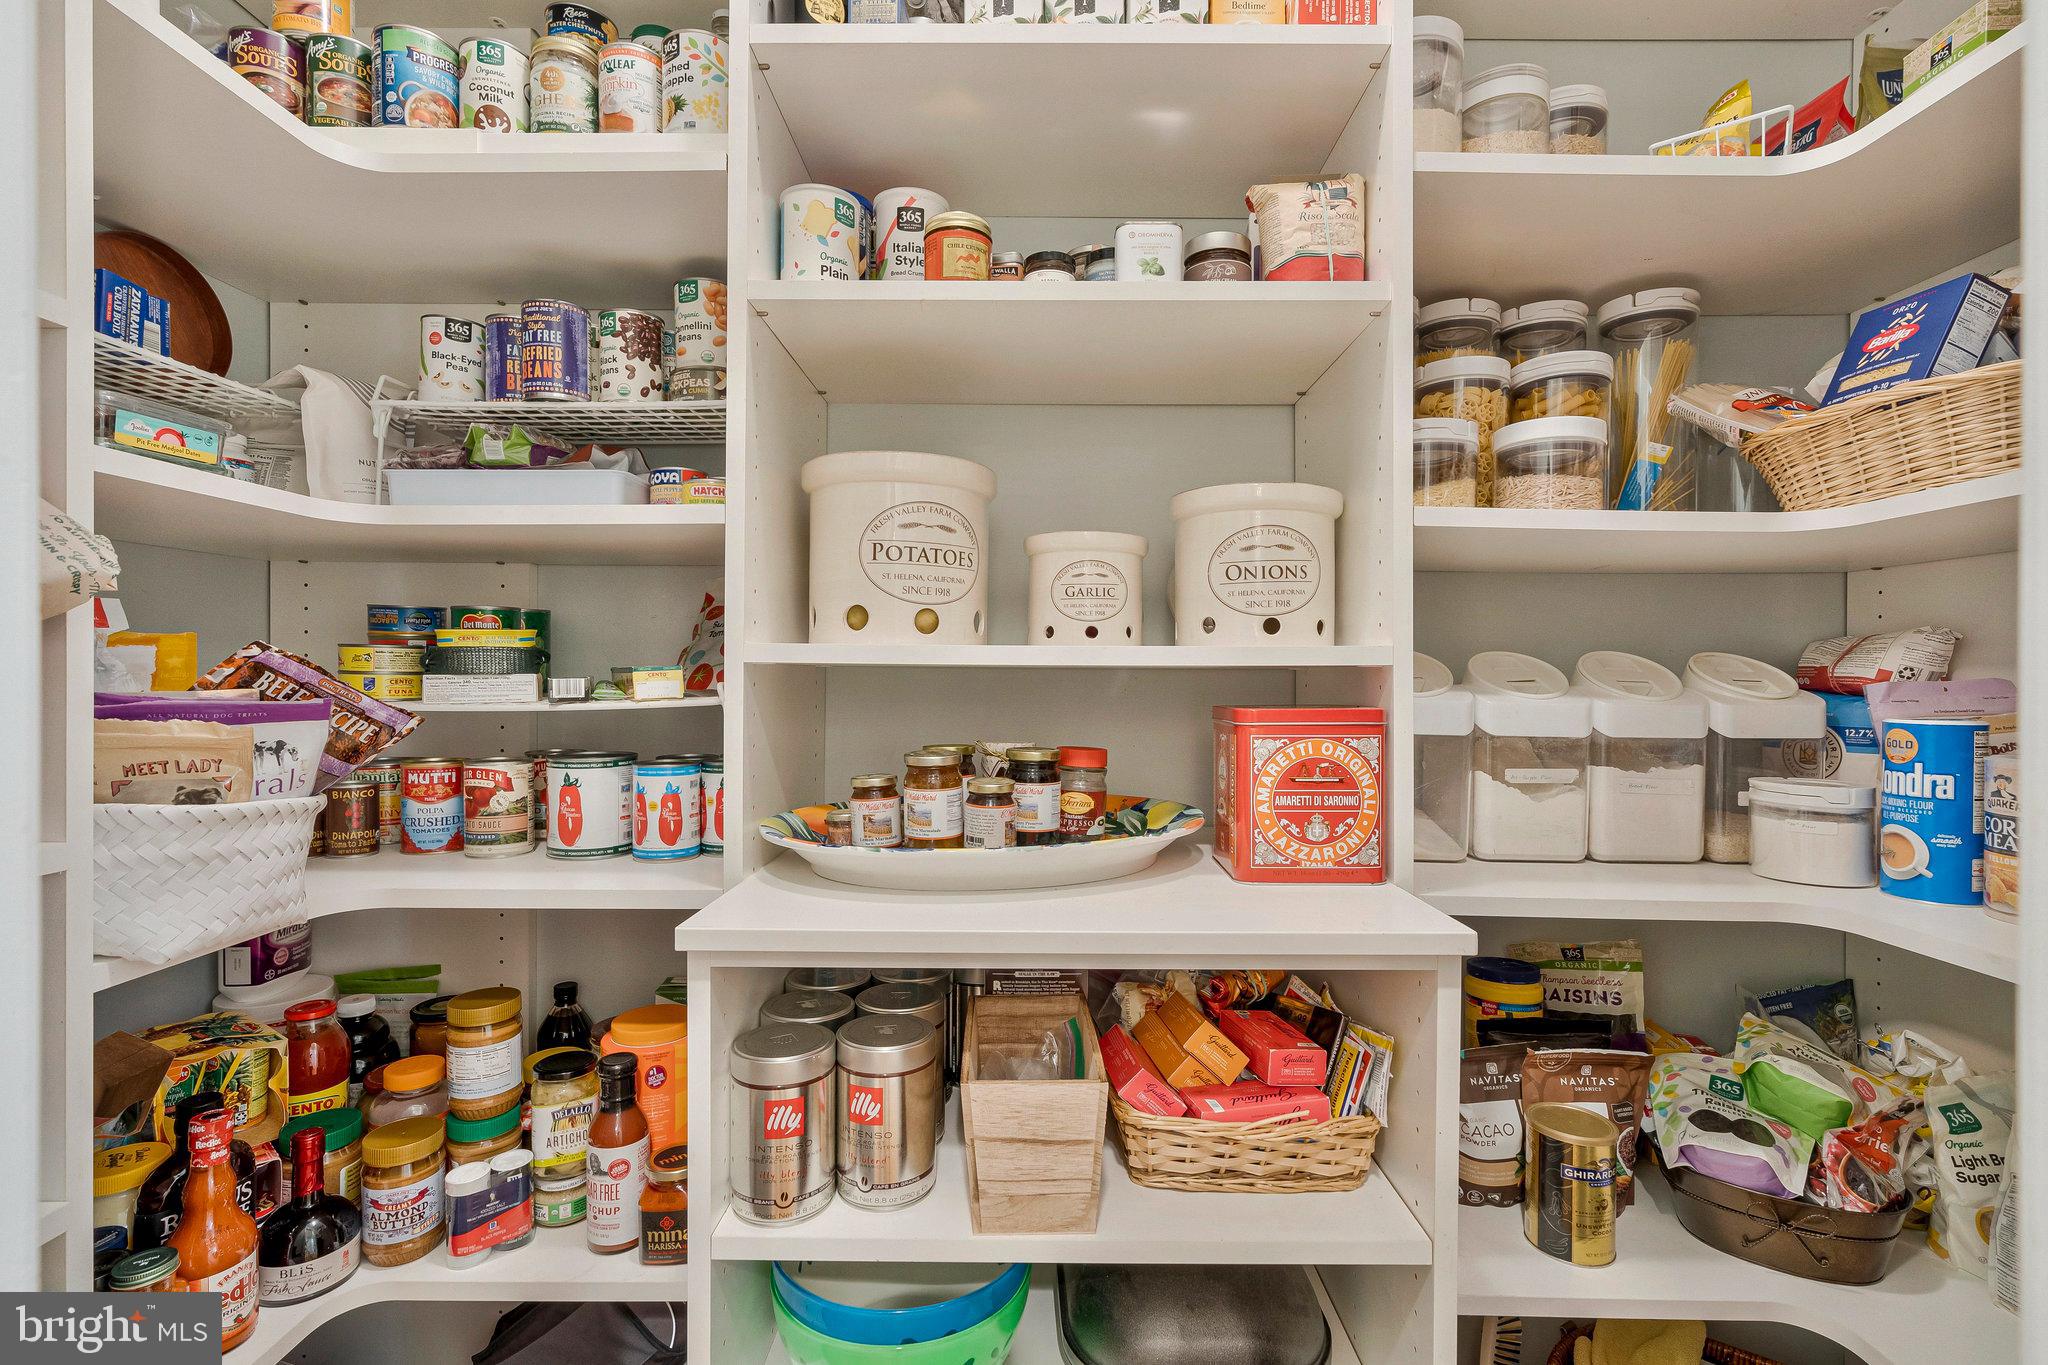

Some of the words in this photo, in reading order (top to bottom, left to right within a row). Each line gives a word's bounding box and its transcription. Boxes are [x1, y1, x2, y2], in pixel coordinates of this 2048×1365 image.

[1232, 1, 1266, 10] Bedtime
[479, 44, 502, 58] 365
[1933, 47, 1949, 63] 365
[236, 45, 298, 77] SOUPS
[319, 51, 372, 81] SOUPS
[329, 52, 364, 67] ORGANIC
[476, 66, 506, 78] Organic
[1919, 49, 1965, 85] ORGANIC
[469, 82, 515, 99] Coconut
[479, 93, 503, 104] Milk
[836, 203, 854, 220] 365
[899, 210, 922, 223] 365
[1300, 211, 1322, 222] Riso
[820, 252, 848, 267] Organic
[895, 255, 924, 268] Style
[820, 265, 849, 280] Plain
[679, 284, 696, 296] 365
[113, 286, 122, 310] CRAB
[1892, 301, 1917, 316] ORZO
[1966, 297, 1985, 310] Calories
[1987, 306, 2000, 316] 200
[112, 311, 120, 335] BOIL
[447, 322, 470, 336] 365
[522, 330, 536, 343] FAT
[538, 329, 562, 343] FREE
[1867, 327, 1915, 349] Barilla
[432, 350, 482, 368] Black-Eyed
[522, 345, 562, 362] REFRIED
[446, 362, 469, 373] Peas
[522, 360, 562, 379] BEANS
[136, 437, 146, 446] Pit
[146, 440, 161, 449] Free
[161, 442, 185, 456] Medjool
[186, 448, 201, 458] Dates
[694, 487, 725, 496] HATCH
[870, 515, 894, 534] FRESH
[895, 505, 927, 517] VALLEY
[929, 506, 953, 519] FARM
[952, 515, 976, 546] COMPANY
[1217, 539, 1237, 558] FRESH
[1237, 529, 1265, 541] VALLEY
[1267, 528, 1289, 537] FARM
[1290, 533, 1317, 560] COMPANY
[871, 542, 974, 568] POTATOES
[1225, 564, 1308, 581] ONIONS
[927, 575, 966, 585] CALIFORNIA
[902, 586, 932, 595] SINCE
[935, 587, 951, 597] 1918
[1065, 586, 1116, 598] GARLIC
[1245, 600, 1273, 608] SINCE
[1275, 600, 1291, 608] 1918
[464, 621, 474, 629] Del
[475, 621, 499, 629] Monte
[1845, 729, 1873, 738] 12.7%
[1887, 738, 1914, 749] GOLD
[122, 760, 169, 778] MEET
[174, 758, 223, 775] LADY
[254, 769, 306, 797] rals
[408, 772, 456, 785] MUTTI
[476, 771, 502, 782] GLEN
[1257, 742, 1313, 813] AMARETTI
[1321, 742, 1376, 815] ORIGINALI
[1882, 759, 1955, 800] ondra
[332, 789, 375, 800] BIANCO
[1275, 795, 1312, 806] AMARETTI
[1315, 795, 1322, 806] DI
[1323, 795, 1359, 806] SARONNO
[1061, 796, 1092, 808] Ferrara
[1910, 800, 1934, 810] FLOUR
[417, 807, 444, 815] POLPA
[404, 814, 461, 828] CRUSHED
[479, 821, 501, 829] SAUCE
[1267, 827, 1365, 861] LAZZARONI
[1931, 837, 1963, 845] smooth
[1565, 949, 1581, 959] 365
[1555, 961, 1598, 969] ORGANIC
[1582, 975, 1624, 987] Seedless
[1780, 1002, 1793, 1011] FREE
[1209, 1034, 1242, 1060] Guittard
[1282, 1054, 1315, 1067] Guittard
[1470, 1073, 1520, 1086] NAVITAS
[1560, 1075, 1615, 1088] NAVITAS
[1712, 1079, 1740, 1095] 365
[1146, 1083, 1175, 1107] Guittard
[1231, 1089, 1297, 1106] Guittard
[554, 1104, 592, 1119] DELALLO
[850, 1092, 879, 1122] illy
[767, 1105, 801, 1131] illy
[1947, 1109, 1974, 1128] 365
[842, 1126, 893, 1140] INTENSO
[1461, 1123, 1515, 1139] CACAO
[754, 1139, 813, 1153] INTENSO
[1461, 1134, 1497, 1147] POWDER
[1945, 1139, 1984, 1152] Organic
[1951, 1154, 1990, 1170] Light
[1956, 1171, 2000, 1187] Sugar
[598, 1183, 620, 1200] FREE
[370, 1202, 428, 1221] ALMOND
[384, 1200, 411, 1211] CREAMY
[373, 1212, 427, 1230] BUTTER
[648, 1241, 682, 1251] HARISSA
